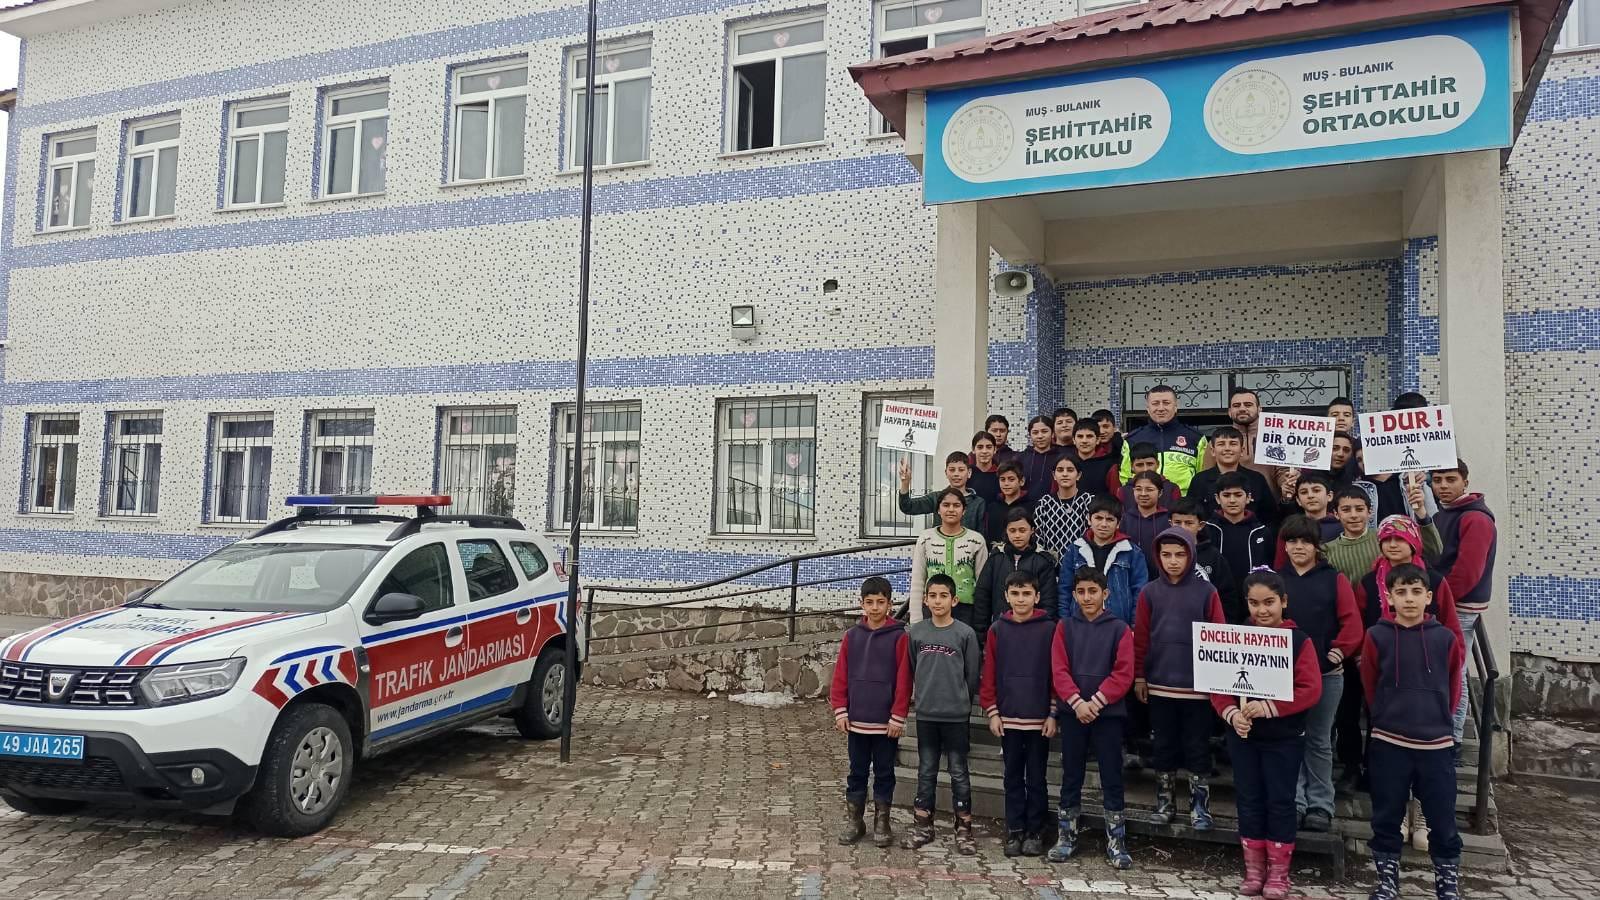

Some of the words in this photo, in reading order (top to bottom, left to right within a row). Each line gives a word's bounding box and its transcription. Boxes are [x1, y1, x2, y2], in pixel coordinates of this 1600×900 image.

[1303, 70, 1329, 82] MUŞ
[1339, 61, 1394, 77] BULANIK
[1302, 75, 1457, 115] ŞEHİTTAHİR
[1025, 106, 1048, 117] MUŞ
[1055, 99, 1101, 113] BULANIK
[1302, 101, 1460, 135] ORTAOKULU
[1025, 112, 1153, 147] ŞEHİTTAHİR
[1025, 139, 1132, 165] İLKOKULU
[883, 415, 911, 427] HAYATA
[911, 419, 937, 430] BAĞLAR
[1264, 414, 1284, 428] BİR
[1288, 418, 1332, 433] KURAL
[1369, 416, 1376, 433] !
[1382, 411, 1431, 432] DUR
[1436, 409, 1443, 427] !
[1262, 430, 1283, 444] BİR
[1286, 431, 1327, 448] ÖMÜR
[1364, 435, 1393, 447] YOLDA
[1394, 432, 1421, 445] BENDE
[1422, 430, 1451, 441] VARIM
[1200, 625, 1241, 645] ÖNCELİK
[1243, 632, 1288, 649] HAYATIN
[375, 659, 434, 700] TRAFİK
[439, 633, 525, 682] JANDARMASI
[1198, 645, 1239, 665] ÖNCELİK
[1241, 652, 1289, 669] YAYA'NIN
[3, 735, 20, 753] 49
[23, 736, 49, 755] JAA
[53, 738, 81, 756] 265
